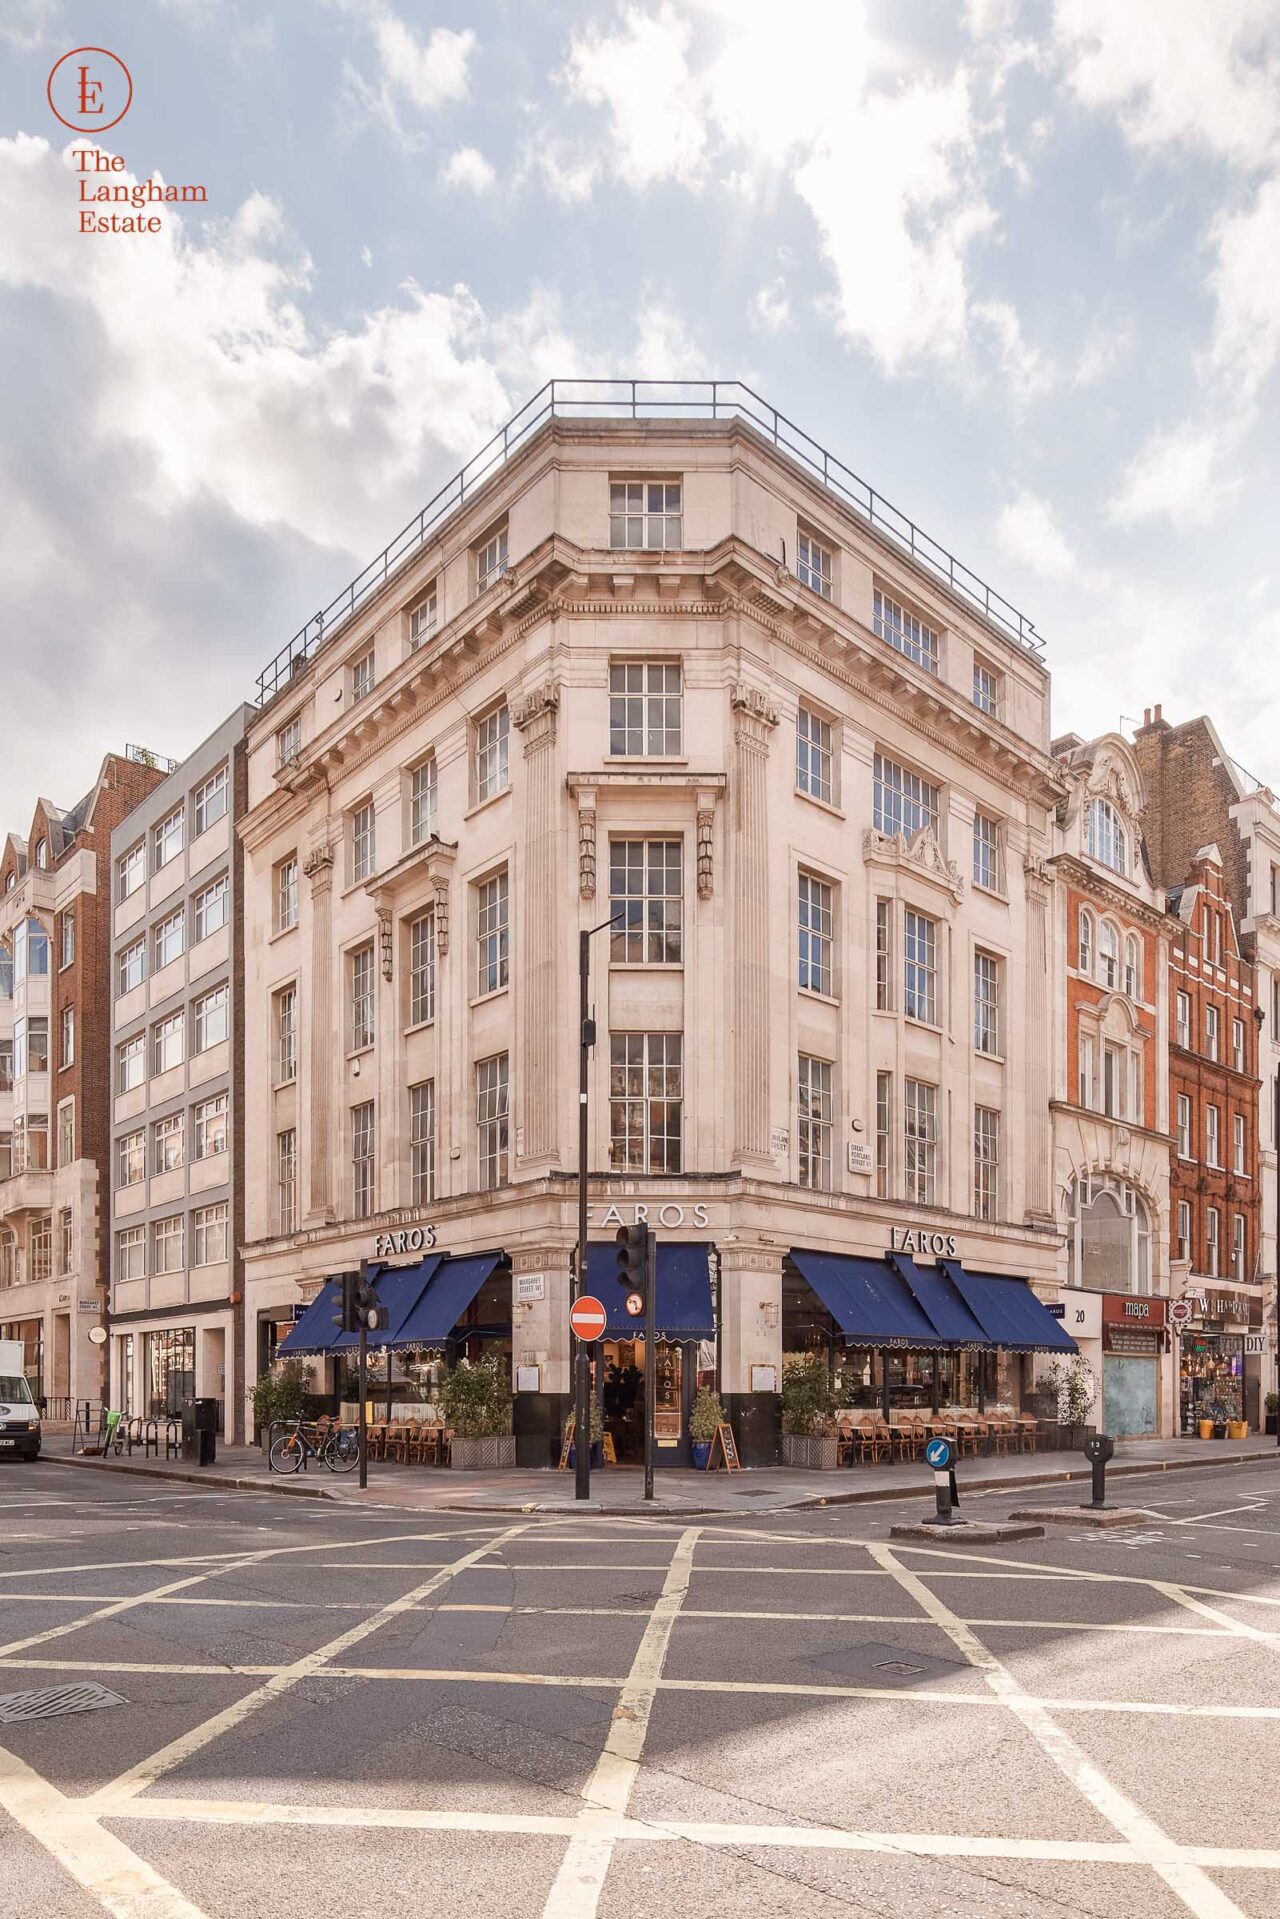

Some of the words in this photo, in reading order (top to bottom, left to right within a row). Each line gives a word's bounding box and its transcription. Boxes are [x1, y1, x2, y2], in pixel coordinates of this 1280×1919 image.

[851, 1144, 864, 1152] GREAT
[852, 1152, 872, 1160] PORTLAND
[376, 1225, 437, 1257] FAROS
[891, 1227, 957, 1257] FAROS
[519, 1277, 541, 1285] MARGARET
[1125, 1302, 1149, 1320] mapa
[1076, 1310, 1085, 1323] 20
[633, 1332, 667, 1340] FAOS
[890, 1337, 909, 1345] FAROS
[1246, 1337, 1265, 1351] DIY
